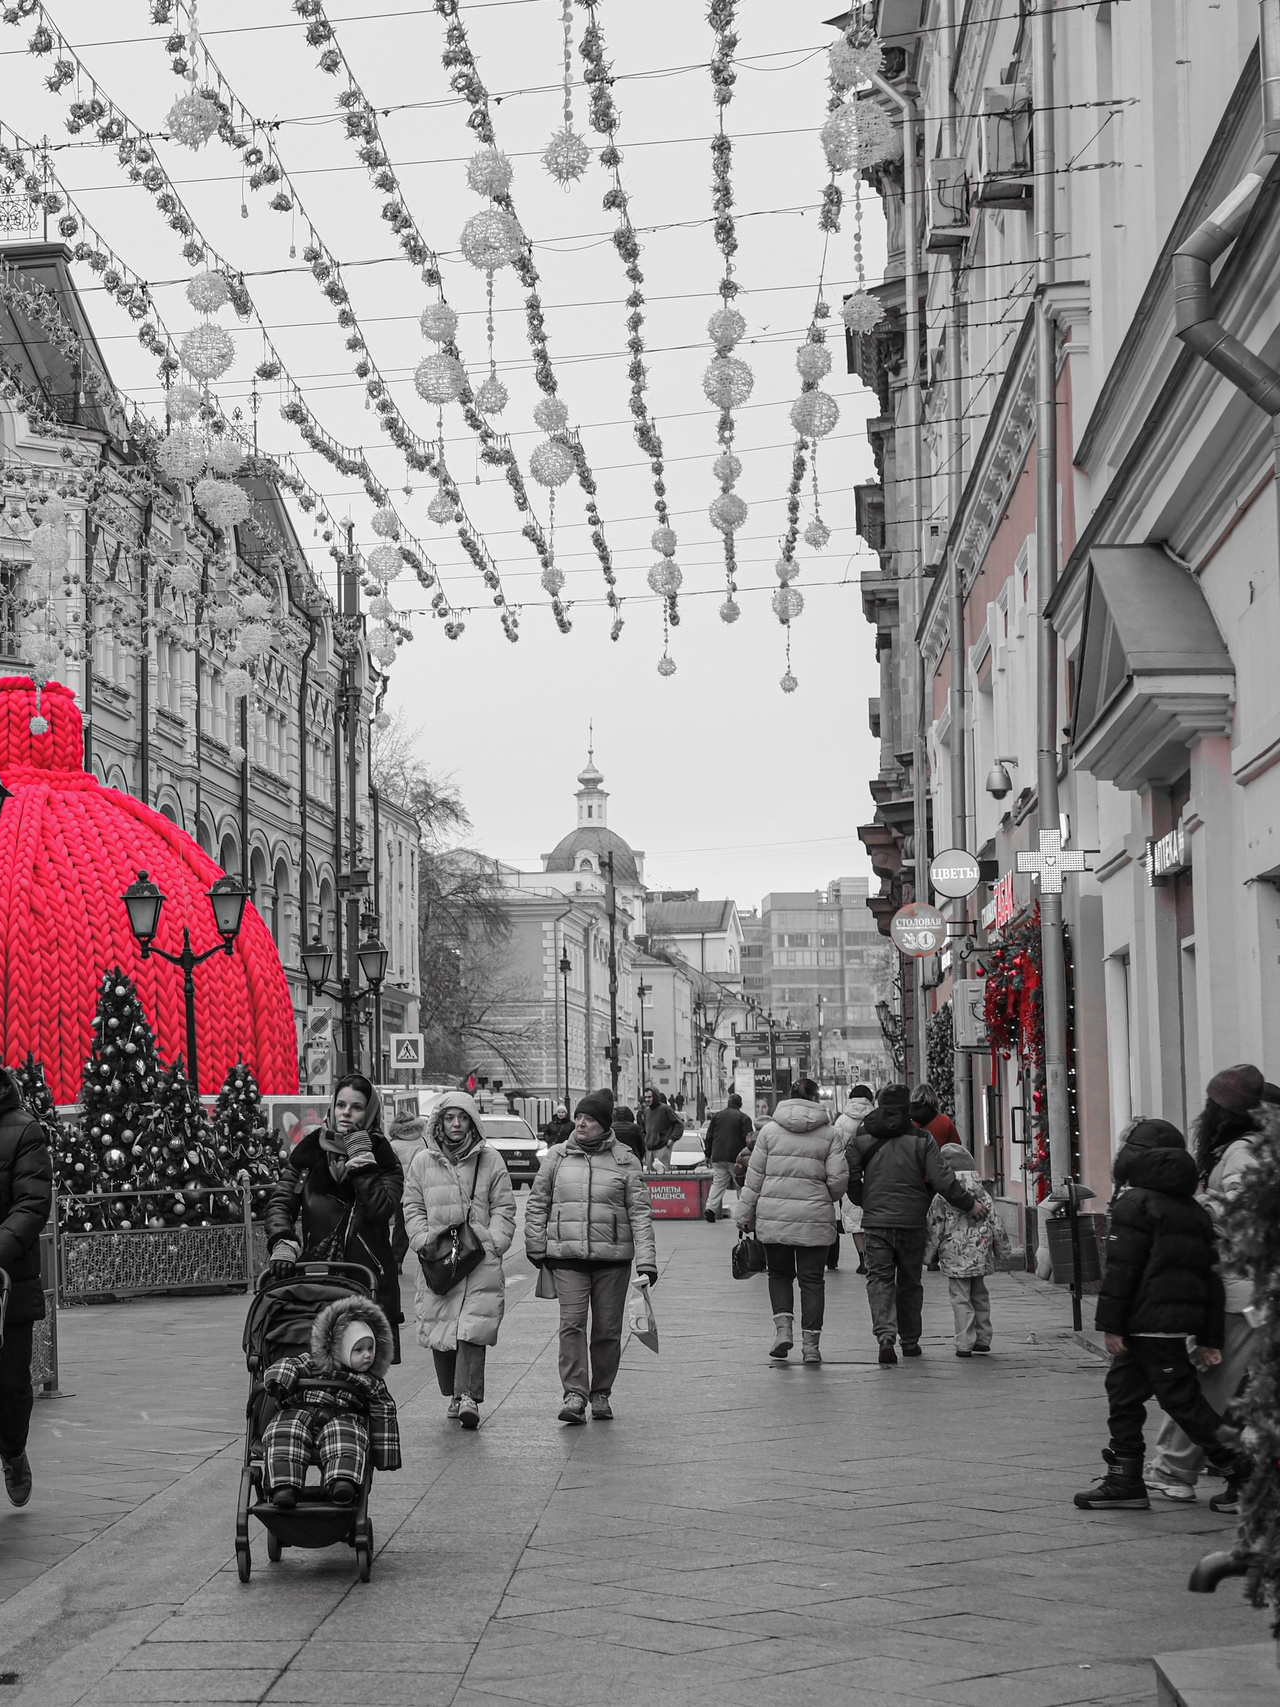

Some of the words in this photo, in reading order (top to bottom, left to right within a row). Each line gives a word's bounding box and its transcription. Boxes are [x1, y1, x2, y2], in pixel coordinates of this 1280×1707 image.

[1154, 829, 1179, 876] АПТЕКА
[931, 867, 979, 882] ЦВЕТЫ
[895, 917, 942, 927] СТОЛОВАЯ
[650, 1193, 686, 1201] НАЦЕНОК
